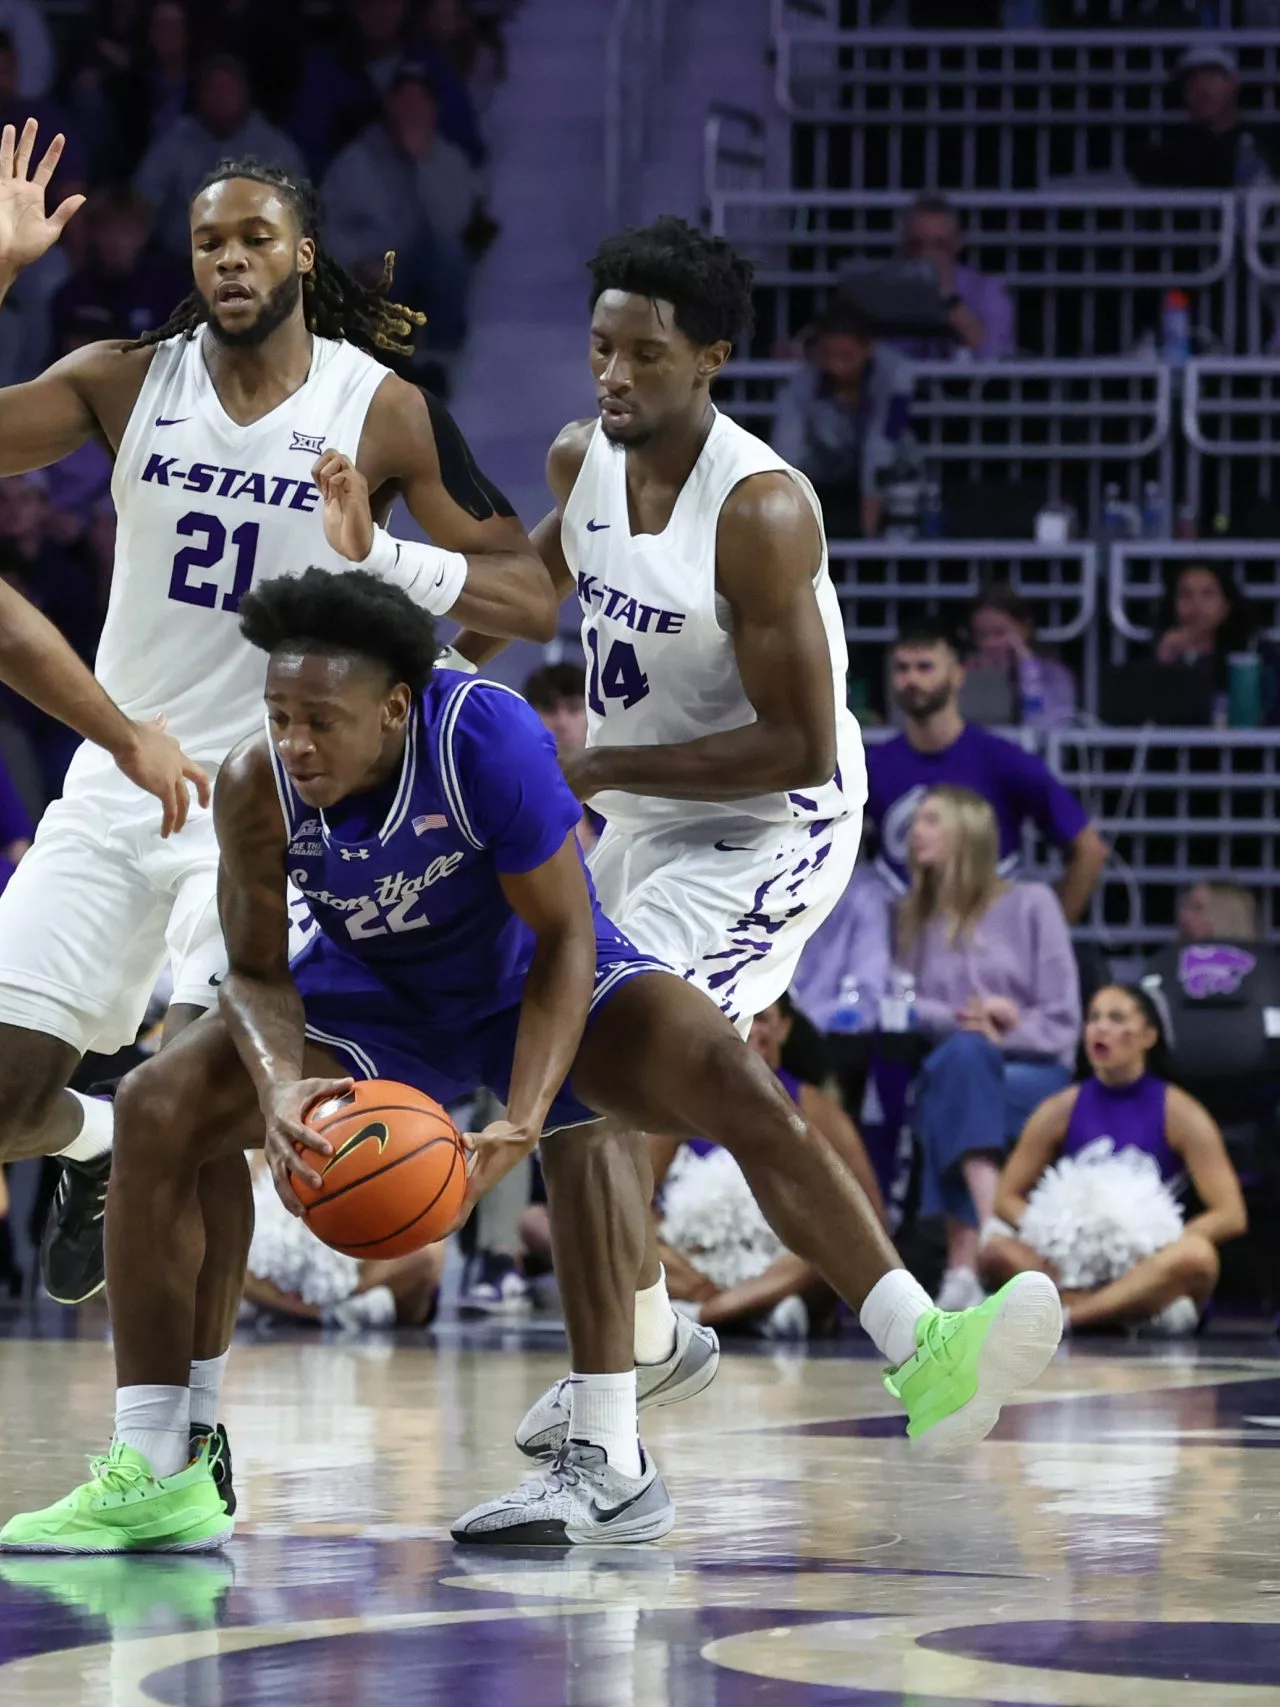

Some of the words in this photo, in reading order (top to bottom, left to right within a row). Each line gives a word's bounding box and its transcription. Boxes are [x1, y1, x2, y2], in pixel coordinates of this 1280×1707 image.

[141, 453, 320, 512] K-STATE
[168, 511, 260, 613] 21
[577, 570, 686, 634] K-TATE
[587, 626, 650, 718] 14
[373, 851, 464, 907] Hall
[344, 892, 431, 941] 22
